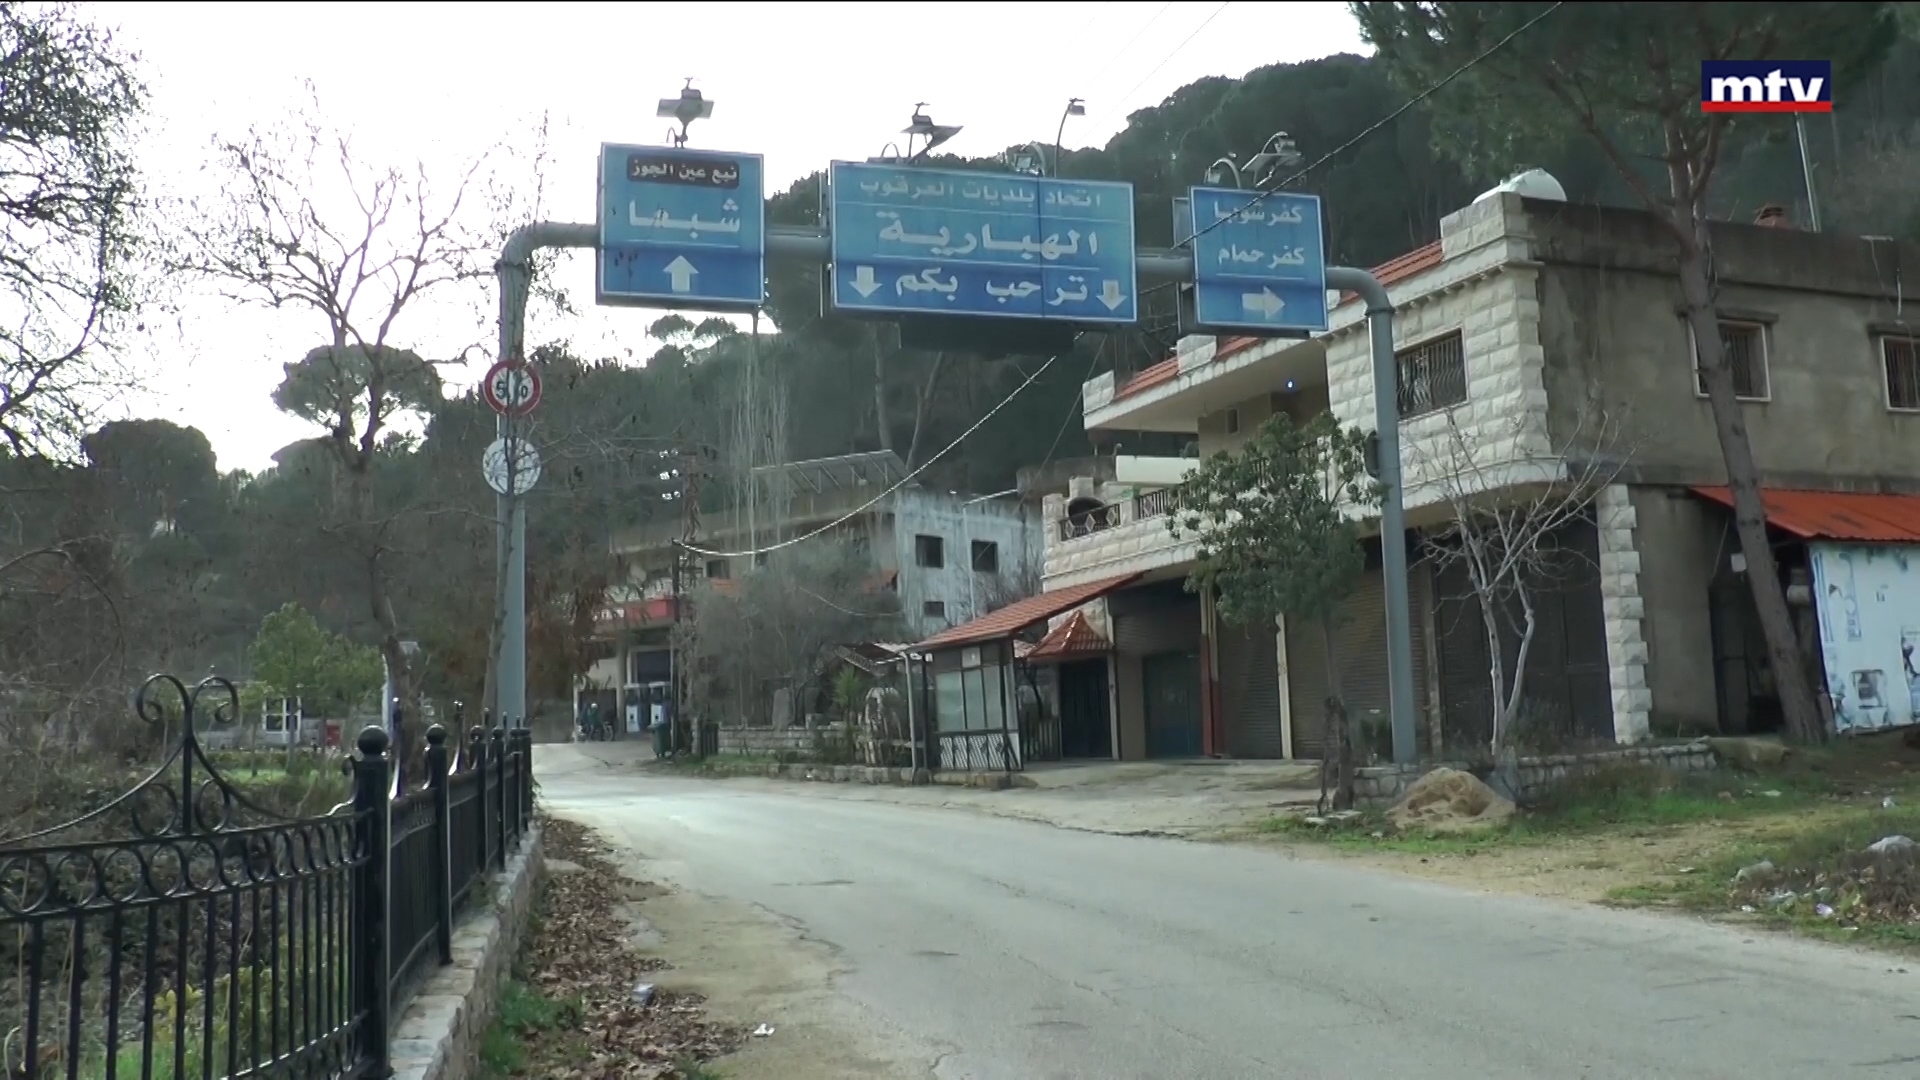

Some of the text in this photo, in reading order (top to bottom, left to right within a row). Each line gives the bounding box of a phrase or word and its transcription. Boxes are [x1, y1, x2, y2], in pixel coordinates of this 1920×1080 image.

[632, 160, 738, 184] نبع عين الجوز
[860, 175, 1101, 208] اتحاد بلديات العرقوب
[629, 198, 740, 239] شبعا
[1214, 201, 1302, 226] كفر شوبا
[876, 211, 1098, 260] الهبارية
[1218, 243, 1305, 269] كفر حمام
[896, 267, 1088, 306] ترحب بكم
